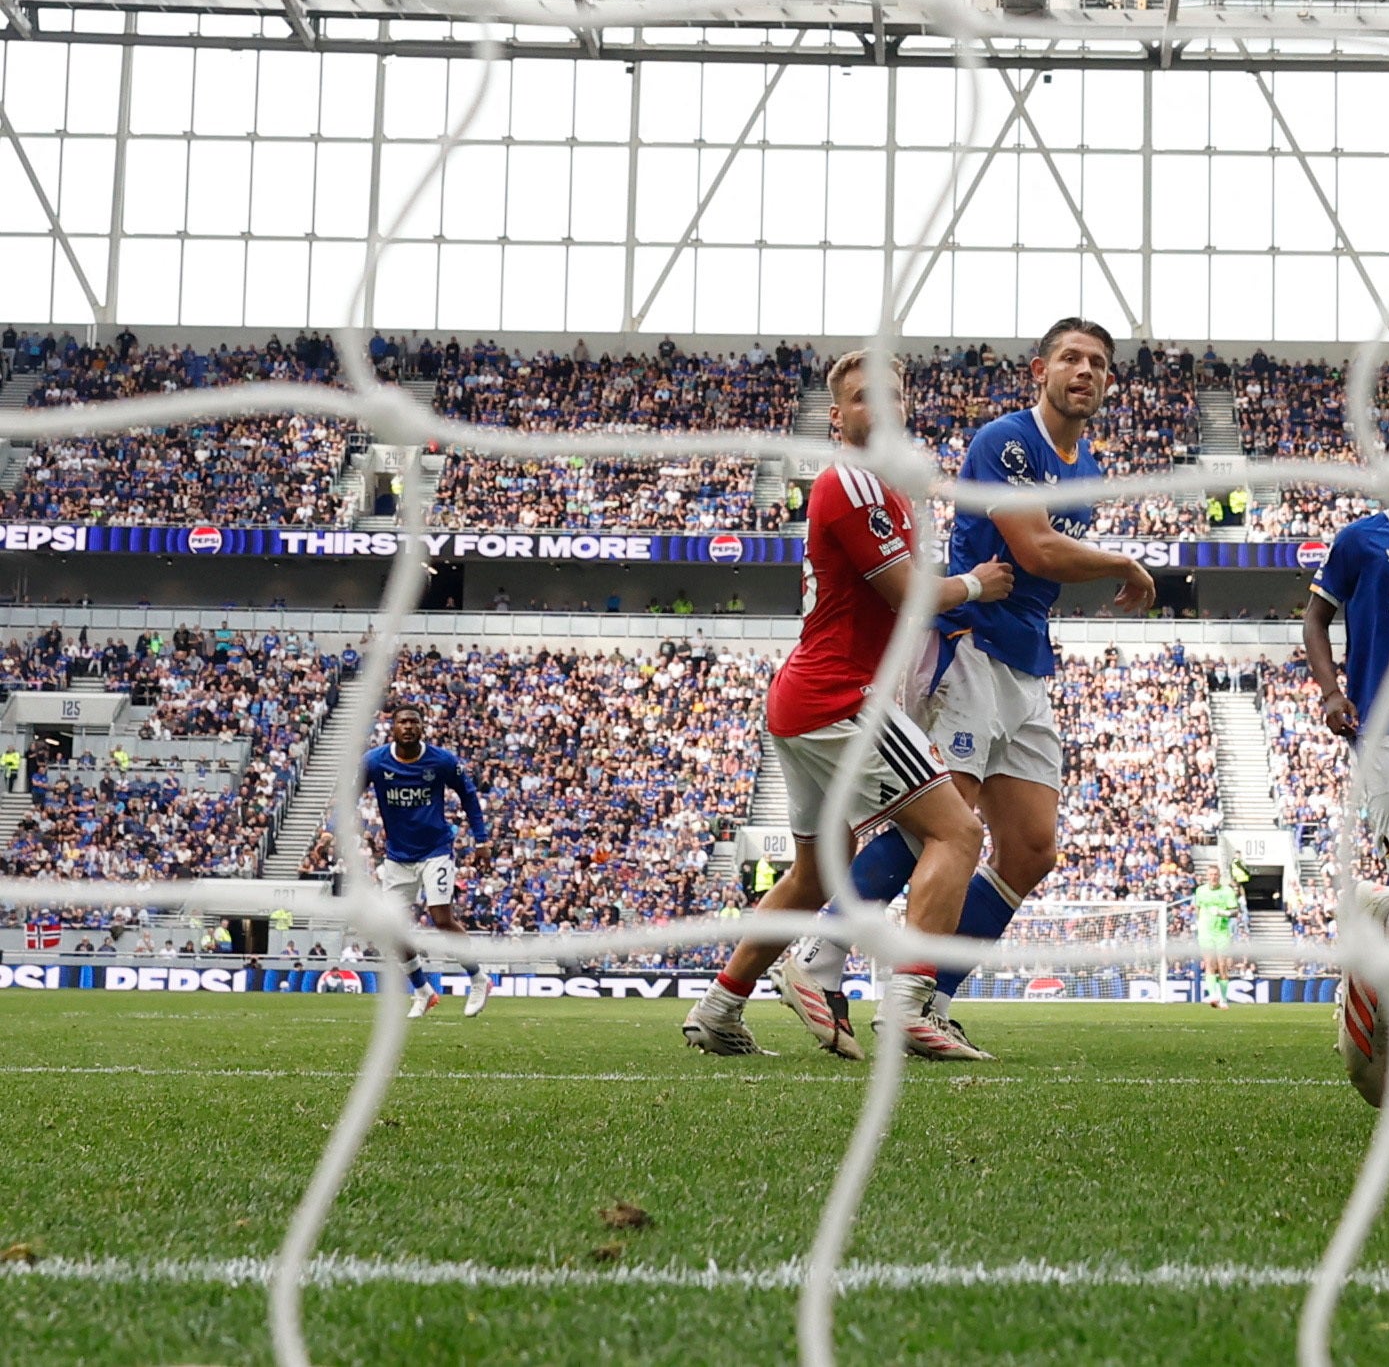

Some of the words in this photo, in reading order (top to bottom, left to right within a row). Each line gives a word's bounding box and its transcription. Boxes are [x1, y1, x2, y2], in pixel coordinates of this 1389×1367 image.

[0, 525, 87, 551] EPSI
[191, 537, 220, 545] PEPSI
[453, 534, 534, 558] FOR
[538, 536, 651, 560] MORE
[711, 546, 740, 554] PEPSI
[1300, 551, 1326, 560] PEPS
[62, 700, 80, 716] 125
[400, 788, 431, 800] CMC
[764, 835, 786, 852] 020
[1245, 840, 1265, 855] 019
[437, 867, 448, 885] 2
[105, 967, 247, 993] PEPSI
[1129, 978, 1270, 1004] PESI
